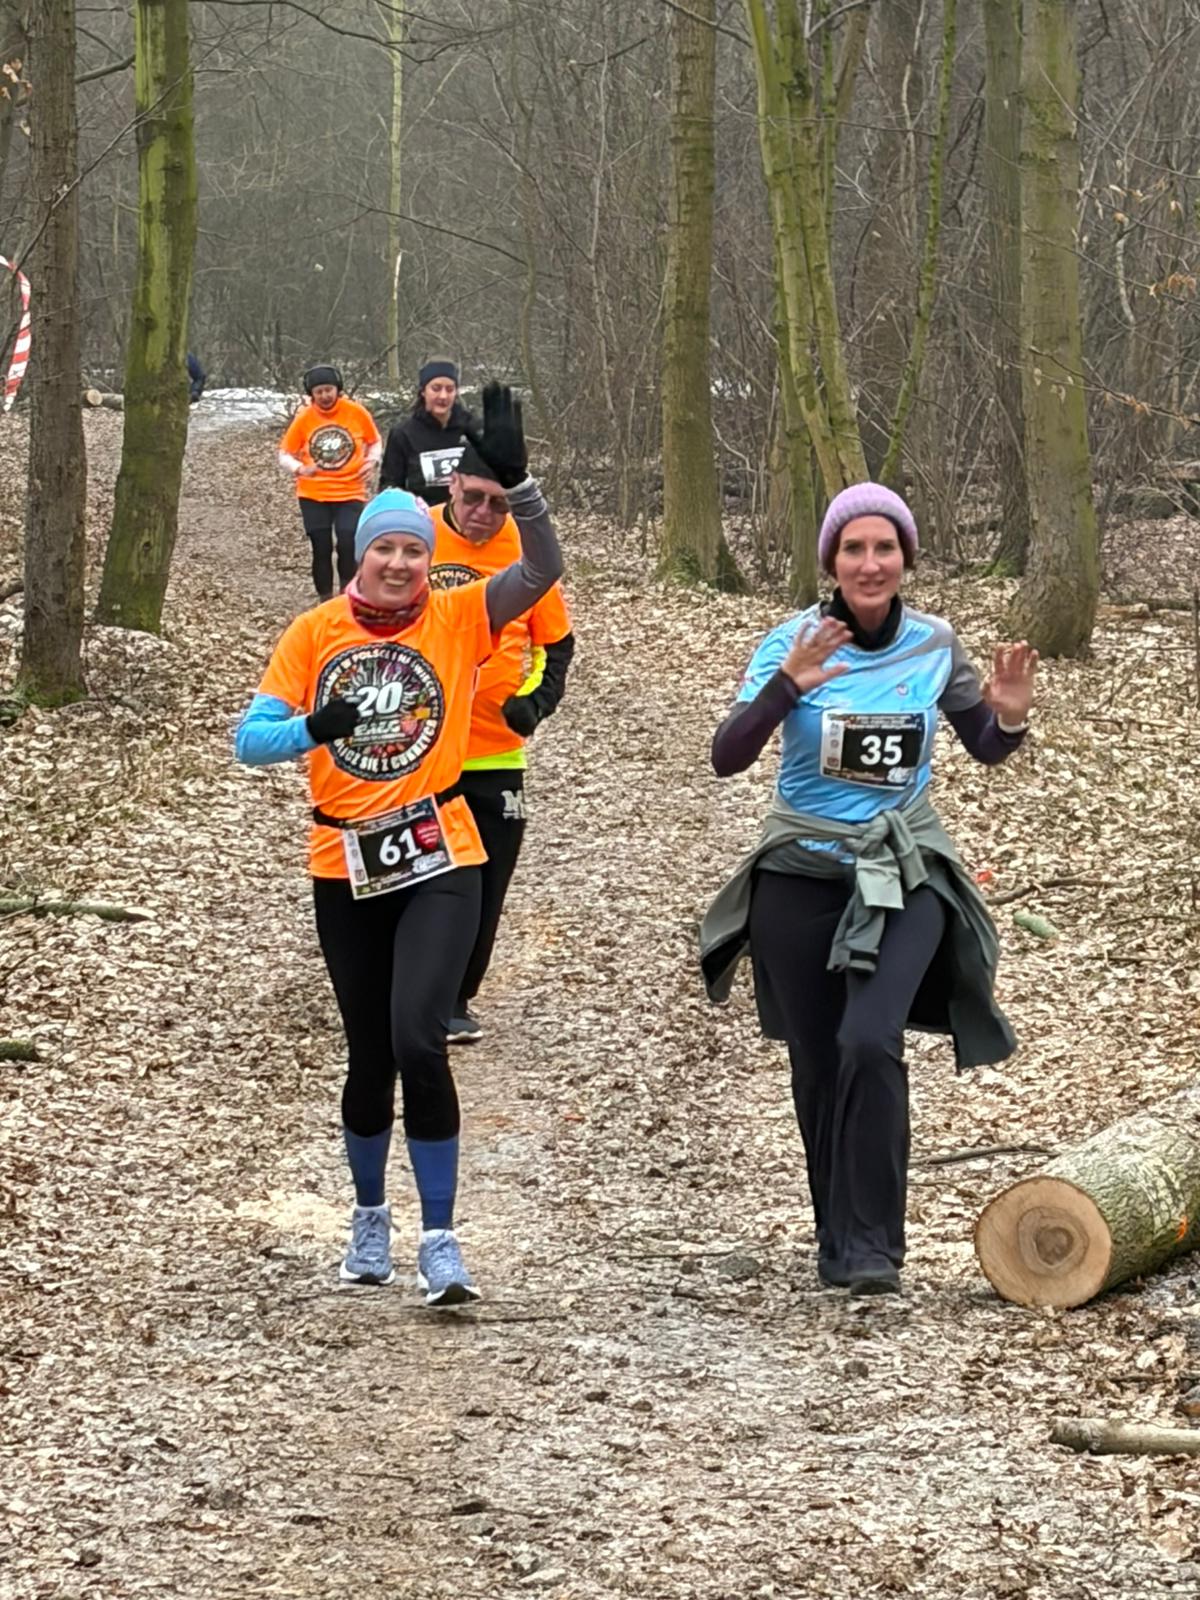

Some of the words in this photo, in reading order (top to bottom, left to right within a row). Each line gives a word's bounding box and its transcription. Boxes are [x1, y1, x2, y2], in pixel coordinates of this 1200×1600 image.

[322, 438, 341, 450] 20
[356, 681, 403, 717] 20
[860, 735, 903, 766] 35
[379, 828, 423, 866] 61
